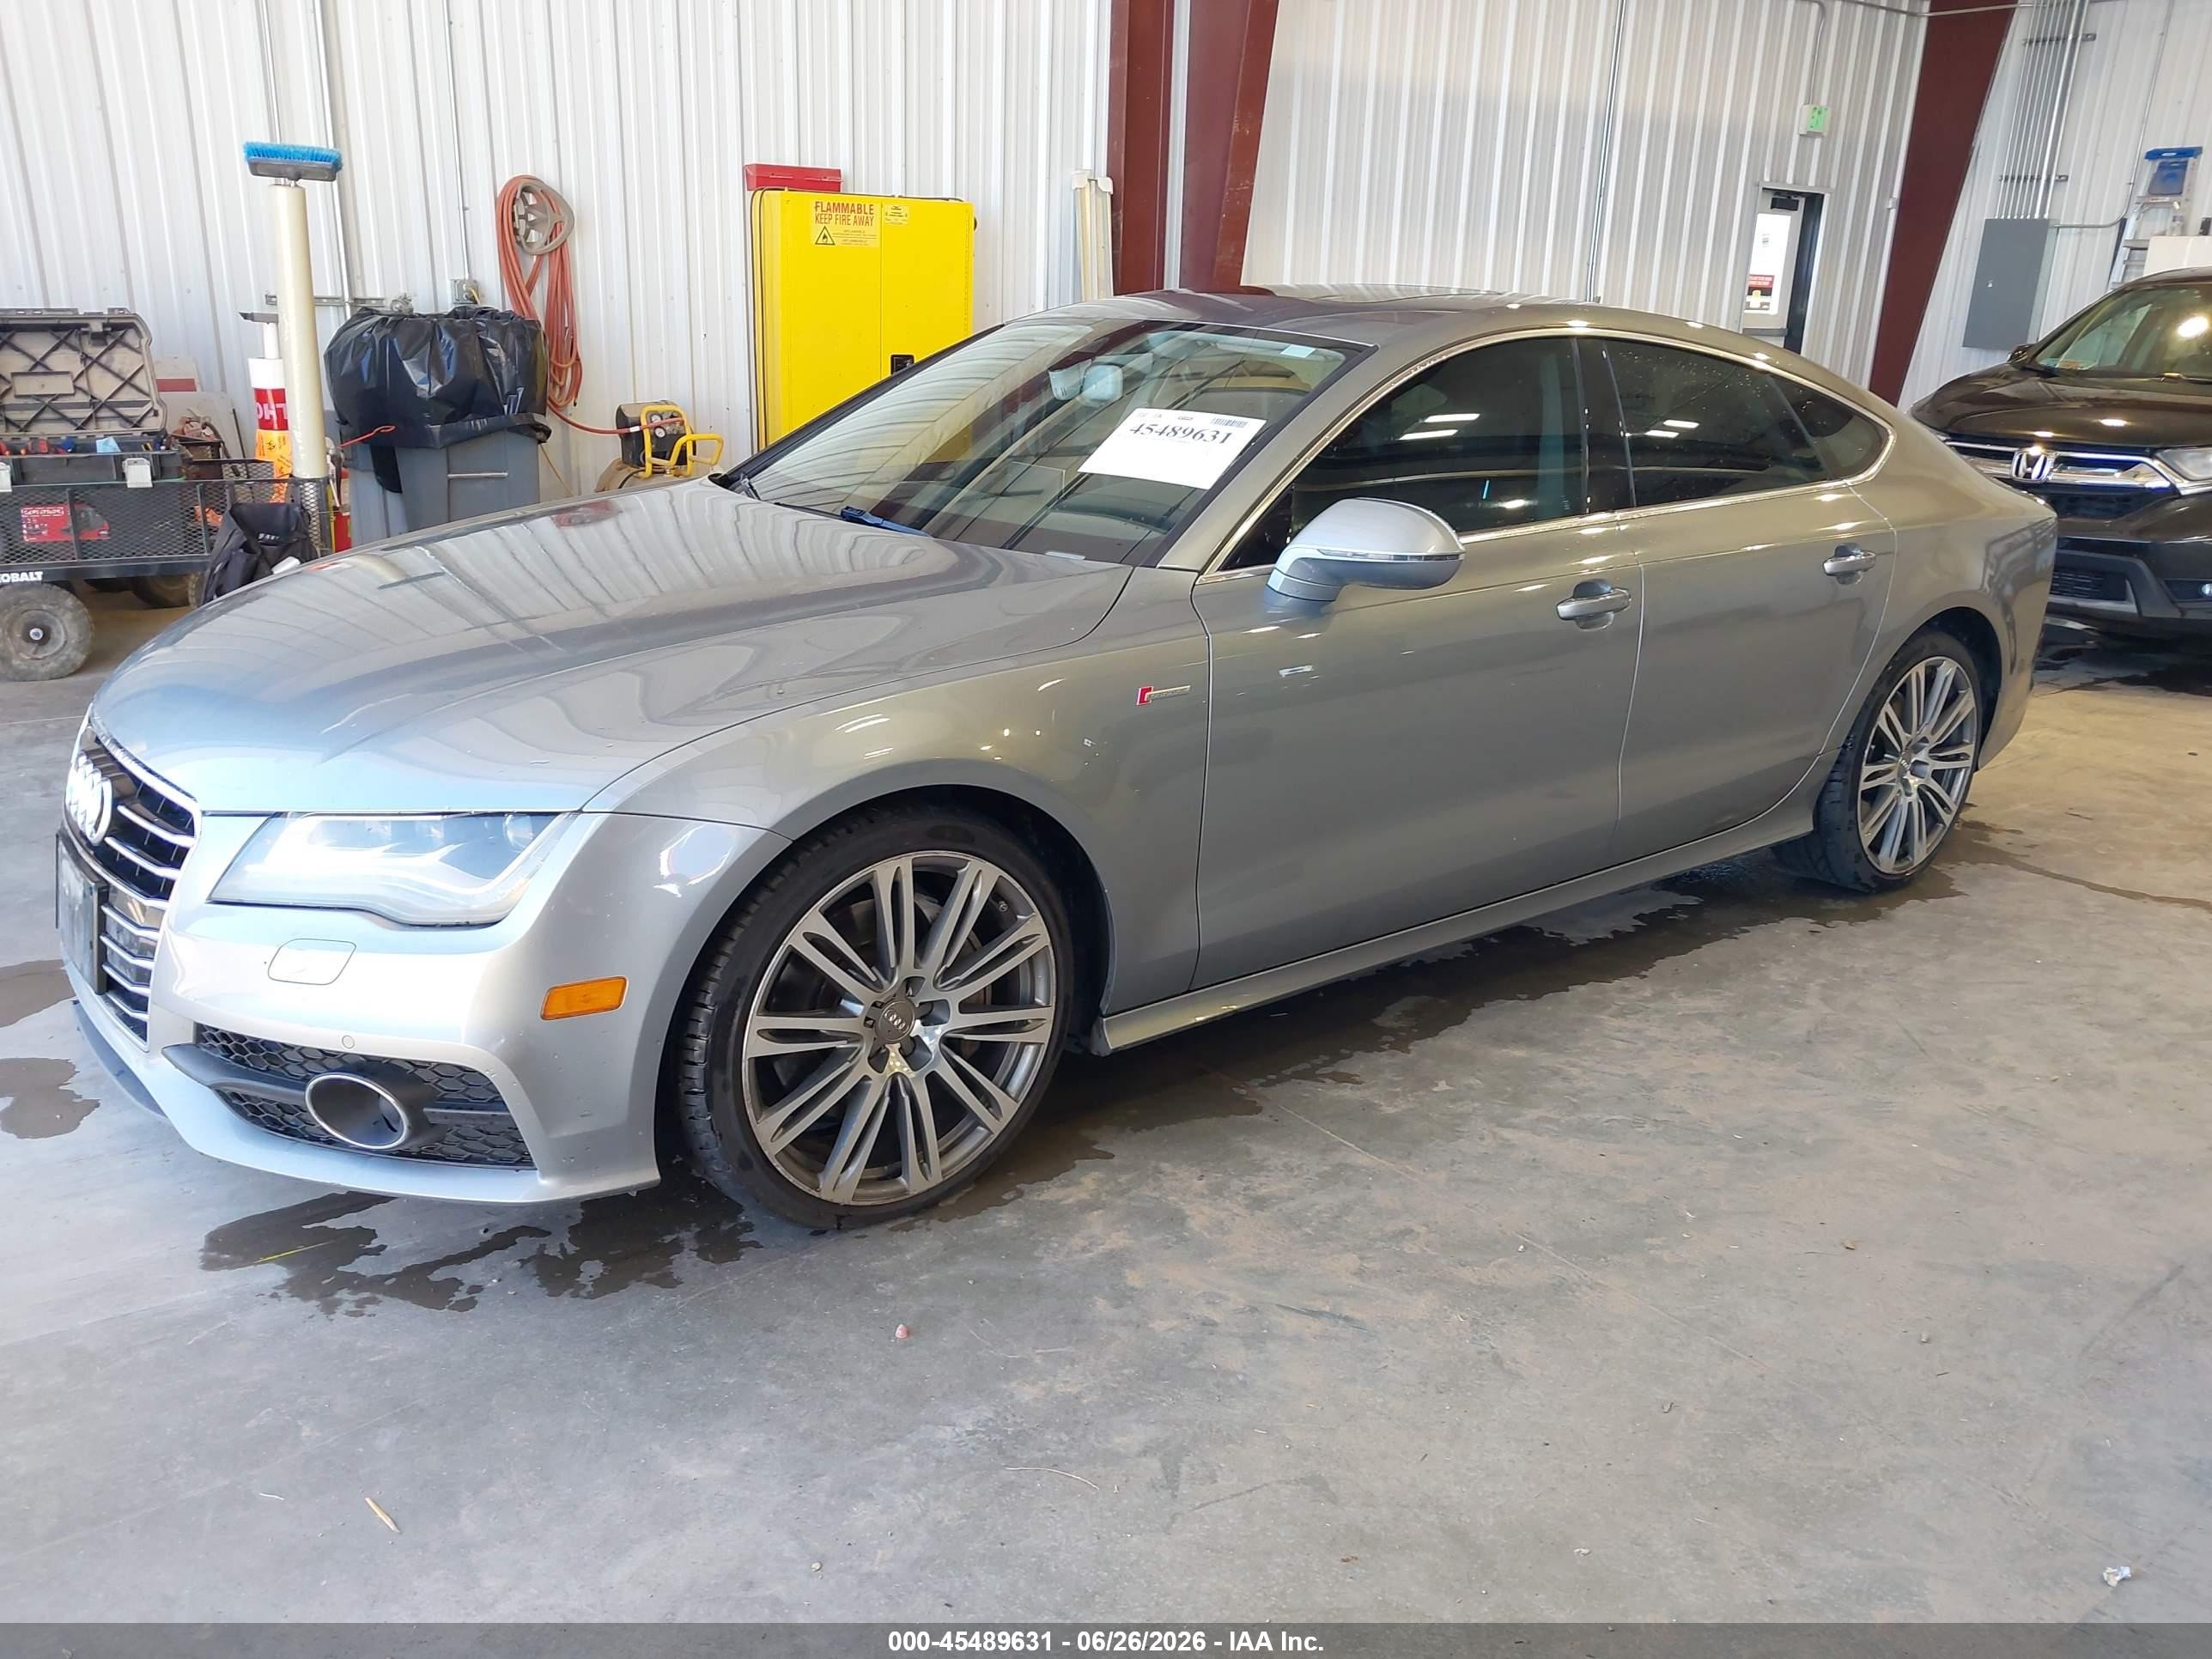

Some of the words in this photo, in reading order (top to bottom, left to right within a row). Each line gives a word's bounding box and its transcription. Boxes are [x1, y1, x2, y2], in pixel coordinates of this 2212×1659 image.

[814, 201, 874, 216] FLAMMABLE
[815, 212, 833, 225] KEEP
[835, 214, 852, 226] FIRE
[853, 215, 875, 227] AWAY
[1129, 422, 1233, 445] 45489631
